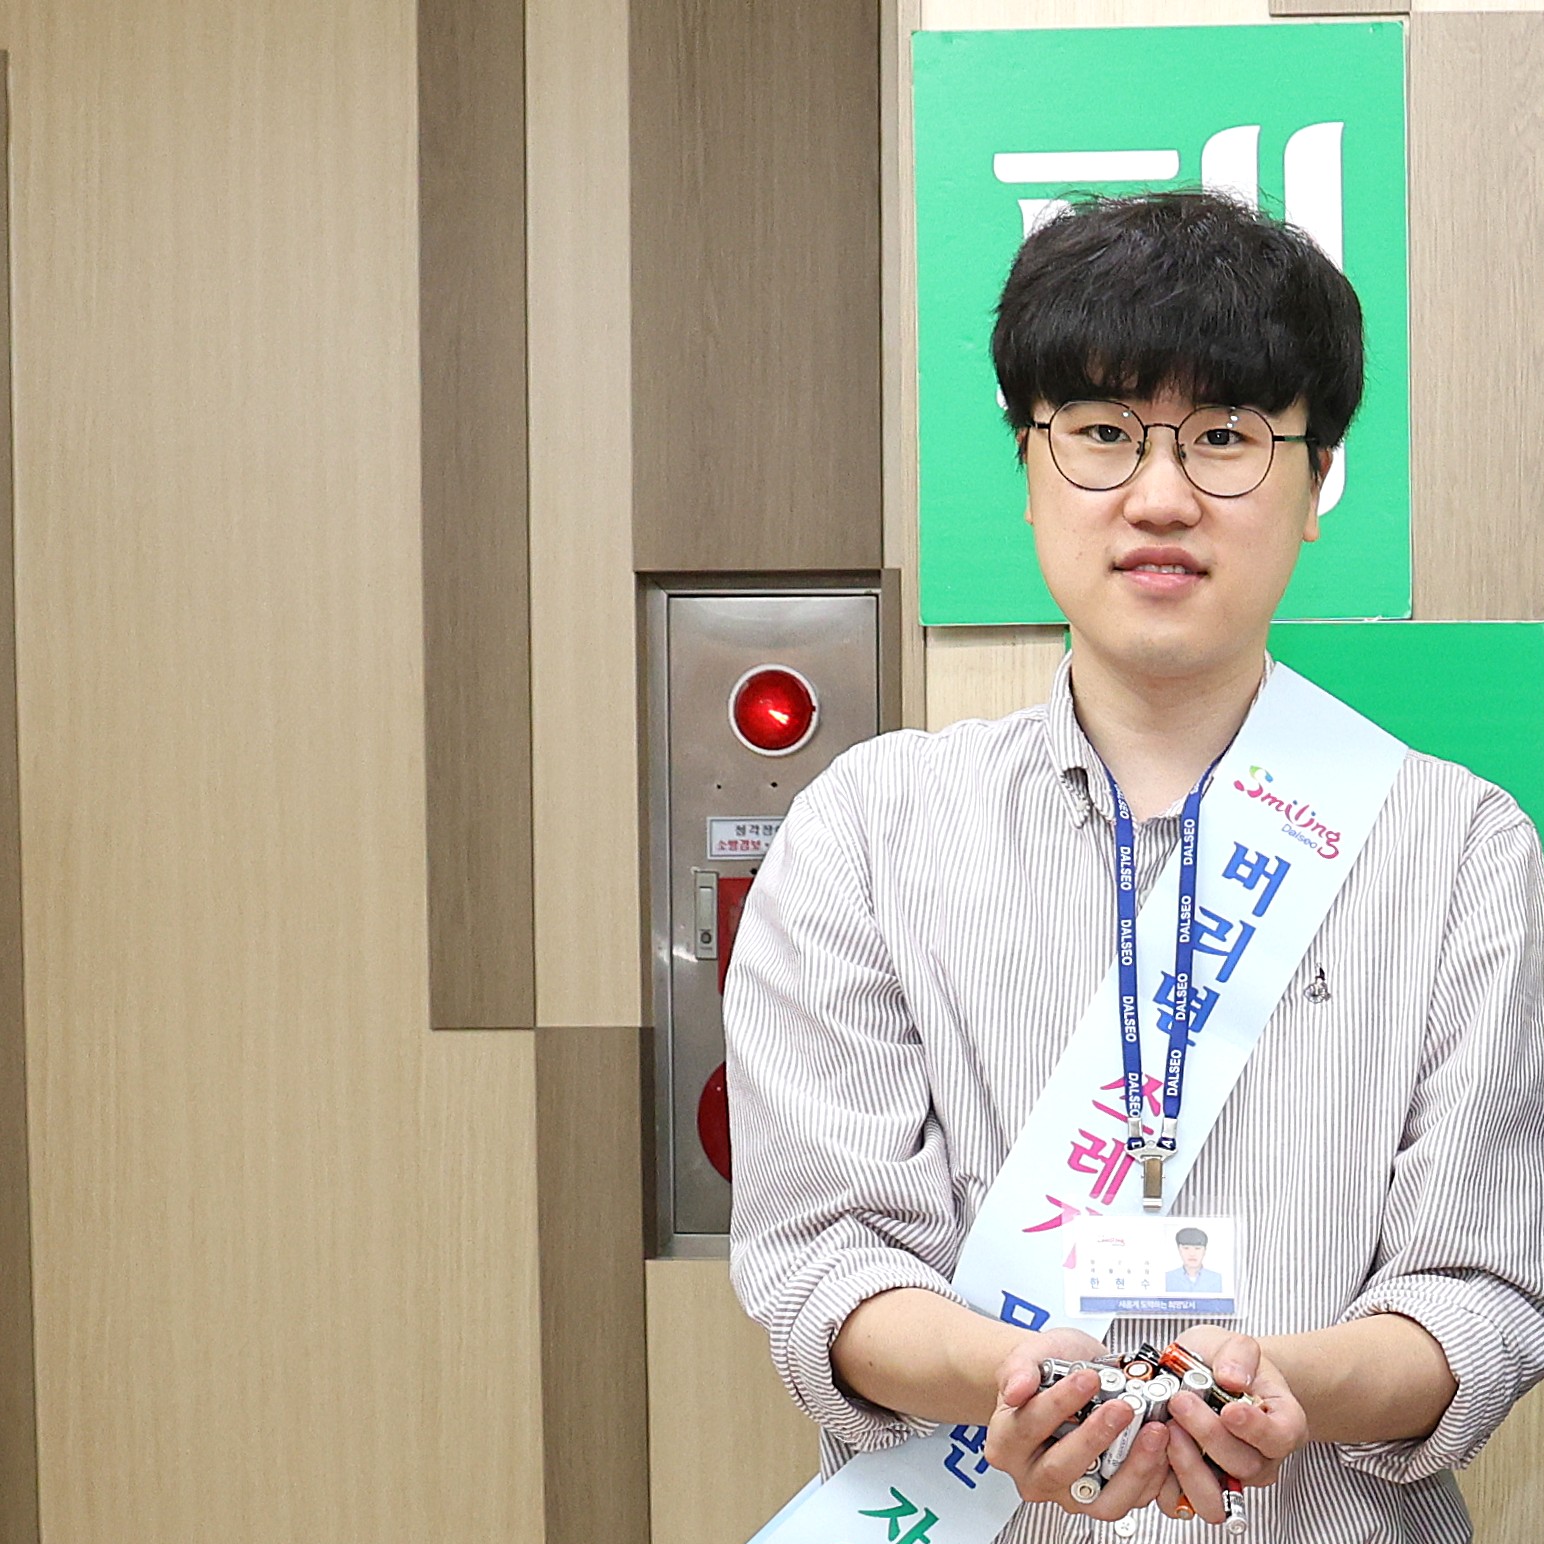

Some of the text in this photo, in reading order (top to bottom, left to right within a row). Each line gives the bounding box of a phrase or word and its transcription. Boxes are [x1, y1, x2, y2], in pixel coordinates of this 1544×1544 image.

[1233, 765, 1343, 860] Smiling
[1281, 823, 1318, 850] Dalseo
[1183, 818, 1195, 866] DALSEO
[1120, 846, 1132, 891] DALSEO
[1120, 919, 1133, 966] DALSEO
[1180, 895, 1191, 943] DALSEO
[1122, 996, 1137, 1043] DALSEO
[1176, 972, 1187, 1021] DALSEO
[1166, 1049, 1183, 1097] DALSEO
